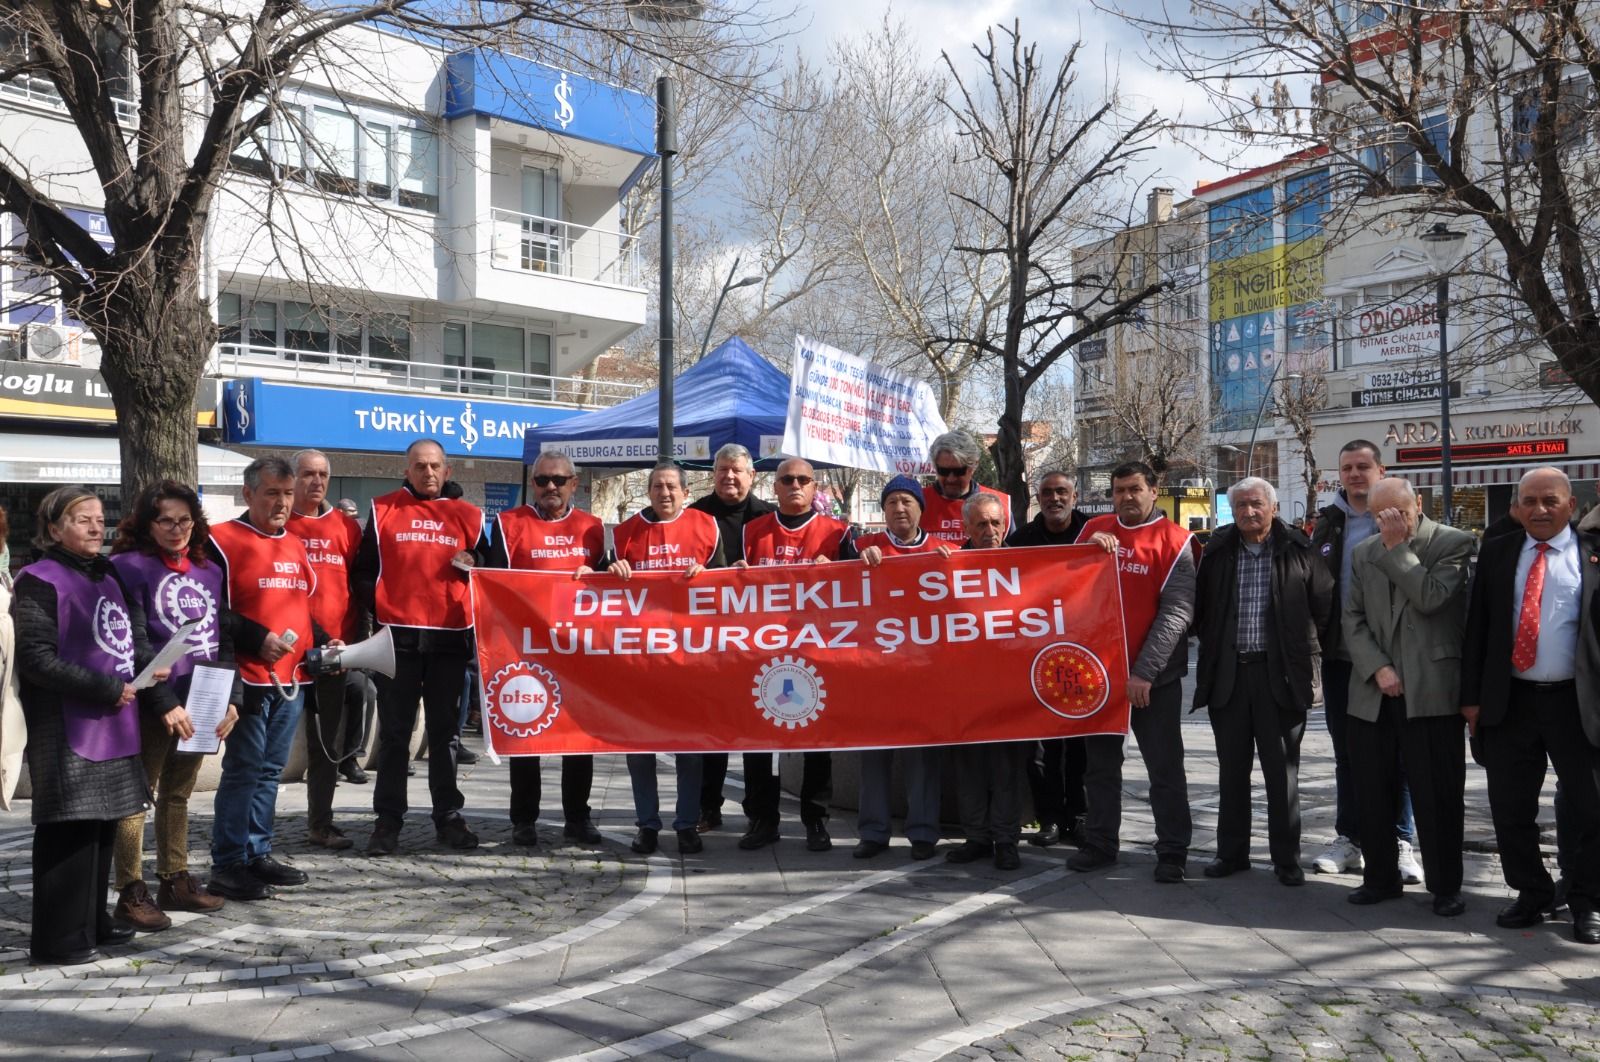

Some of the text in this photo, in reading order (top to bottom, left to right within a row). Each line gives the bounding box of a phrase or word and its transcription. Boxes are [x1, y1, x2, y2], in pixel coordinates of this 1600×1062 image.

[1391, 329, 1441, 344] CİHAZLAR
[1371, 373, 1392, 388] 0532
[85, 379, 113, 398] İL
[808, 370, 829, 388] GÜNDE
[897, 399, 912, 413] GAZ
[1360, 390, 1393, 408] İŞİTME
[354, 406, 456, 436] TÜRKİYE
[831, 414, 861, 433] PERŞEMBE
[626, 442, 687, 456] BELEDESİ
[895, 458, 916, 473] KÖY
[1093, 504, 1114, 513] LAHMA
[412, 519, 445, 531] DEV
[395, 532, 459, 548] EMEKLİ-SEN
[544, 535, 575, 546] DEV
[531, 545, 591, 559] EMEKLİ-SEN
[649, 544, 681, 556] DEV
[776, 546, 804, 557] DEV
[1118, 546, 1135, 559] EV
[307, 552, 345, 566] KLİ-SEN
[635, 556, 698, 571] EMEKLİ-SEN
[273, 562, 301, 574] DEV
[573, 588, 649, 617] DEV
[687, 570, 872, 616] EMEKLİ
[918, 567, 1021, 602] SEN
[179, 594, 206, 609] DİSK
[109, 616, 128, 631] DİSK
[522, 598, 1066, 656] LÜLEBURGAZ ŞUBESİ
[502, 689, 545, 704] DİSK
